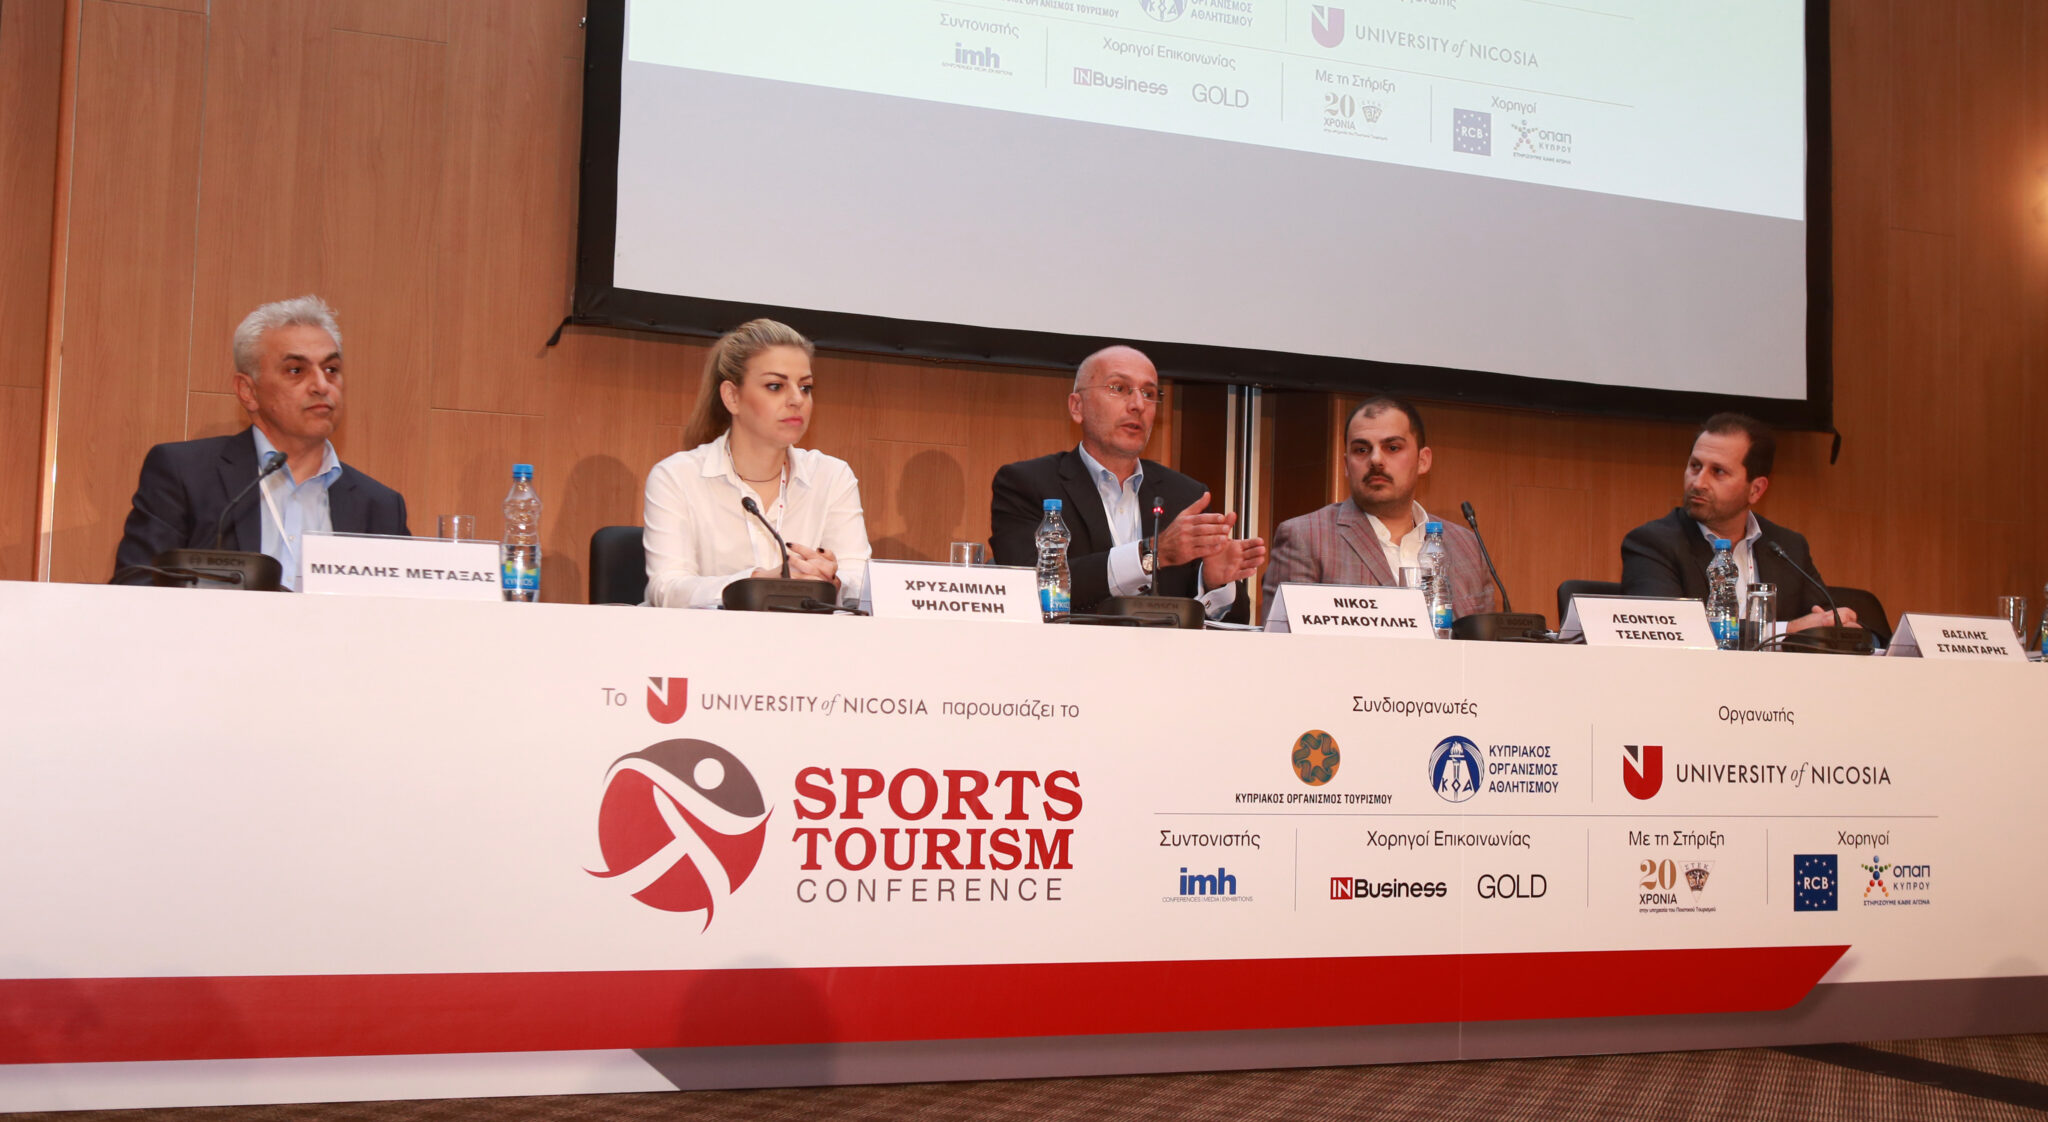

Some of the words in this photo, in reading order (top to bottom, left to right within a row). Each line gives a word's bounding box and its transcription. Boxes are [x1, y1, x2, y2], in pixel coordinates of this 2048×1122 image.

[1076, 5, 1120, 19] ΤΟΥΡΙΣΜΟΥ
[1190, 8, 1254, 28] ΑΘΛΗΤΙΣΜΟΥ
[940, 13, 1020, 39] Συντονιστής
[955, 42, 1001, 69] imh
[1103, 36, 1154, 58] Χορηγοί
[1157, 45, 1237, 71] Επικοινωνίας
[1355, 24, 1450, 53] UNIVERSITY
[1451, 39, 1468, 58] of
[1470, 43, 1539, 68] NICOSIA
[1315, 69, 1334, 84] Με
[1336, 74, 1349, 86] τη
[1352, 74, 1396, 94] Στήριξη
[1192, 83, 1249, 109] GOLD
[1324, 92, 1355, 118] 20
[1491, 96, 1537, 115] Χορηγοί
[1324, 117, 1356, 130] ΧΡΟΝΙΑ
[1461, 126, 1483, 139] RCB
[311, 563, 400, 578] ΜΙΧΑΛΗΣ
[406, 567, 496, 583] ΜΕΤΑΞΑΣ
[905, 580, 1006, 596] ΧΡΥΣΑΙΜΙΛΗ
[911, 599, 1005, 614] ΨΗΛΟΓΕΝΗ
[1333, 597, 1378, 610] ΝΙΚΟΣ
[1302, 614, 1418, 629] ΚΑΡΤΑΚΟΥΛΛΗΣ
[1612, 613, 1677, 626] ΛΕΟΝΤΙΟΣ
[1615, 629, 1685, 642] ΤΣΕΛΕΠΟΣ
[1942, 629, 1989, 641] ΒΑΣΙΛΗΣ
[1937, 643, 2009, 656] ΣΤΑΜΑΤΑΡΗΣ
[701, 693, 818, 713] UNIVERSITY
[821, 693, 841, 716] of
[844, 697, 928, 715] NICOSIA
[942, 699, 1055, 721] παρουσιάζει
[1060, 703, 1080, 718] το
[1352, 695, 1478, 717] Συνδιοργανωτές
[1718, 705, 1795, 726] Οργανωτής
[1489, 745, 1551, 758] ΚΥΠΡΙΑΚΟΣ
[1488, 762, 1558, 776] ΟΡΓΑΝΙΣΜΟΣ
[1676, 763, 1787, 784] UNIVERSITY
[1790, 761, 1809, 788] of
[1811, 765, 1892, 786] NICOSIA
[793, 766, 1083, 822] SPORTS
[1488, 780, 1559, 793] ΑΘΛΗΤΙΣΜΟΥ
[1235, 793, 1284, 804] ΚΥΠΡΙΑΚΟΣ
[1287, 793, 1342, 804] ΟΡΓΑΝΙΣΜΟΣ
[1344, 794, 1393, 805] ΤΟΥΡΙΣΜΟΥ
[792, 827, 1075, 872] TOURISM
[1159, 829, 1261, 850] Συντονιστής
[1366, 829, 1430, 850] Χορηγοί
[1434, 829, 1531, 850] Επικοινωνίας
[1628, 830, 1651, 847] Με
[1654, 834, 1669, 847] τη
[1673, 830, 1725, 849] Στήριξη
[1837, 830, 1890, 850] Χορηγοί
[1179, 867, 1236, 895] imh
[1640, 858, 1677, 890] 20
[1803, 875, 1829, 890] RCB
[796, 877, 1063, 903] CONFERENCE
[1477, 873, 1547, 899] GOLD
[1893, 881, 1930, 891] ΚΥΠΡΟΥ
[1639, 893, 1678, 905] ΧΡΟΝΙΑ
